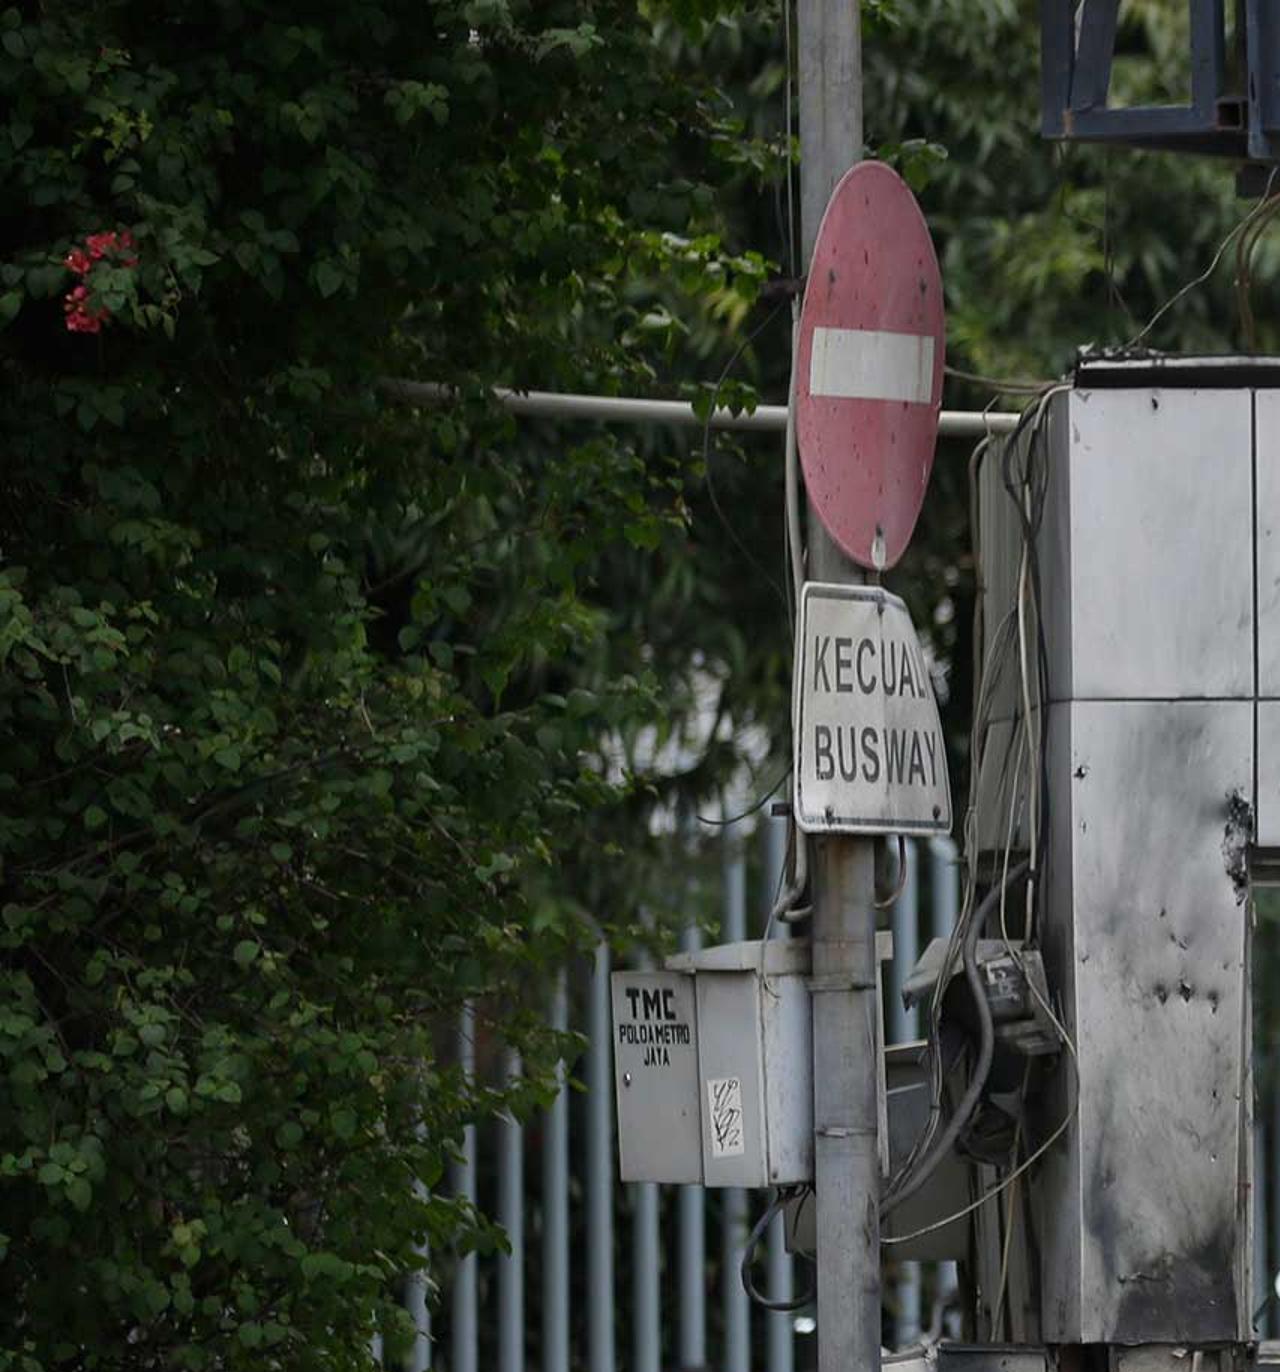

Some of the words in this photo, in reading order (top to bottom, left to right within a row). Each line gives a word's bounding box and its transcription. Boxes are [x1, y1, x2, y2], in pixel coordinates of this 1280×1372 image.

[815, 724, 936, 787] BUSWAY
[625, 988, 676, 1020] TMC
[644, 1046, 670, 1066] JAYA
